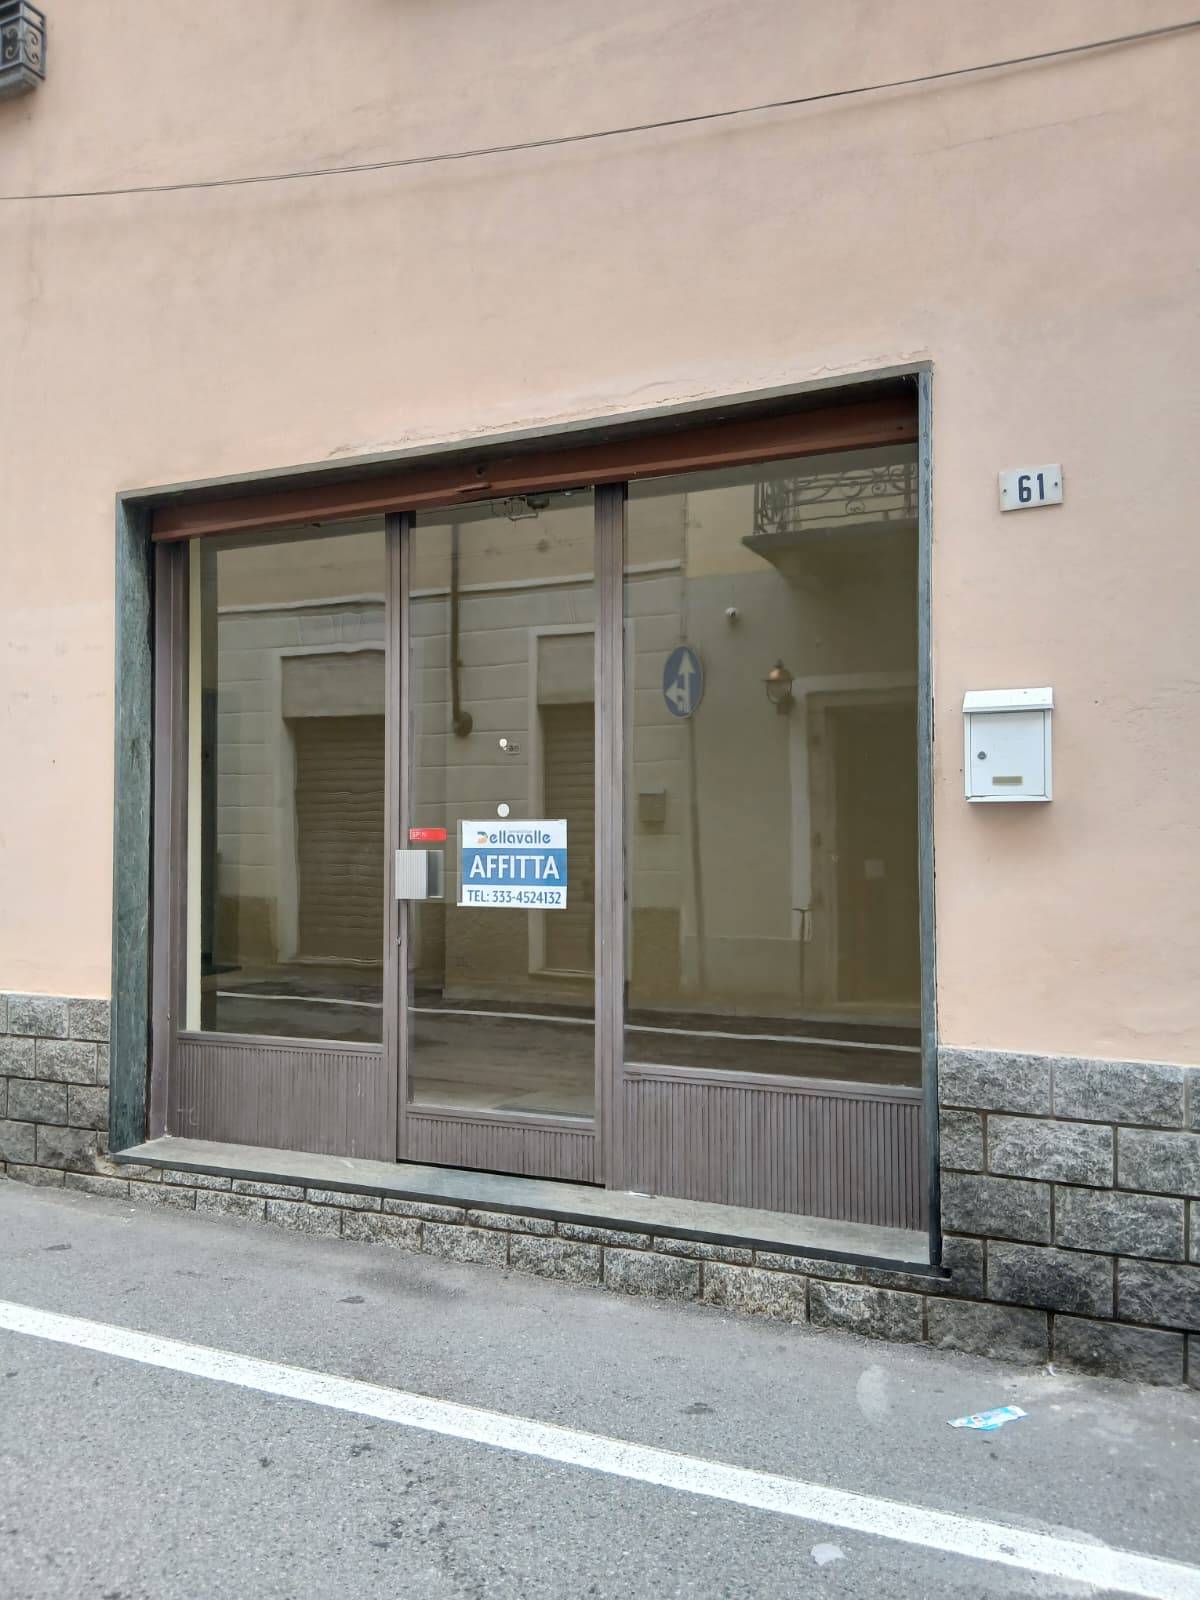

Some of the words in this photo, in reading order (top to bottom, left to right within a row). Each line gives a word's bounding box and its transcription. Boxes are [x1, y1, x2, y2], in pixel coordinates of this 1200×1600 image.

[1018, 473, 1045, 503] 61
[469, 855, 560, 880] AFFITTA
[467, 890, 490, 904] TEL:
[492, 891, 562, 905] 333-4524132
